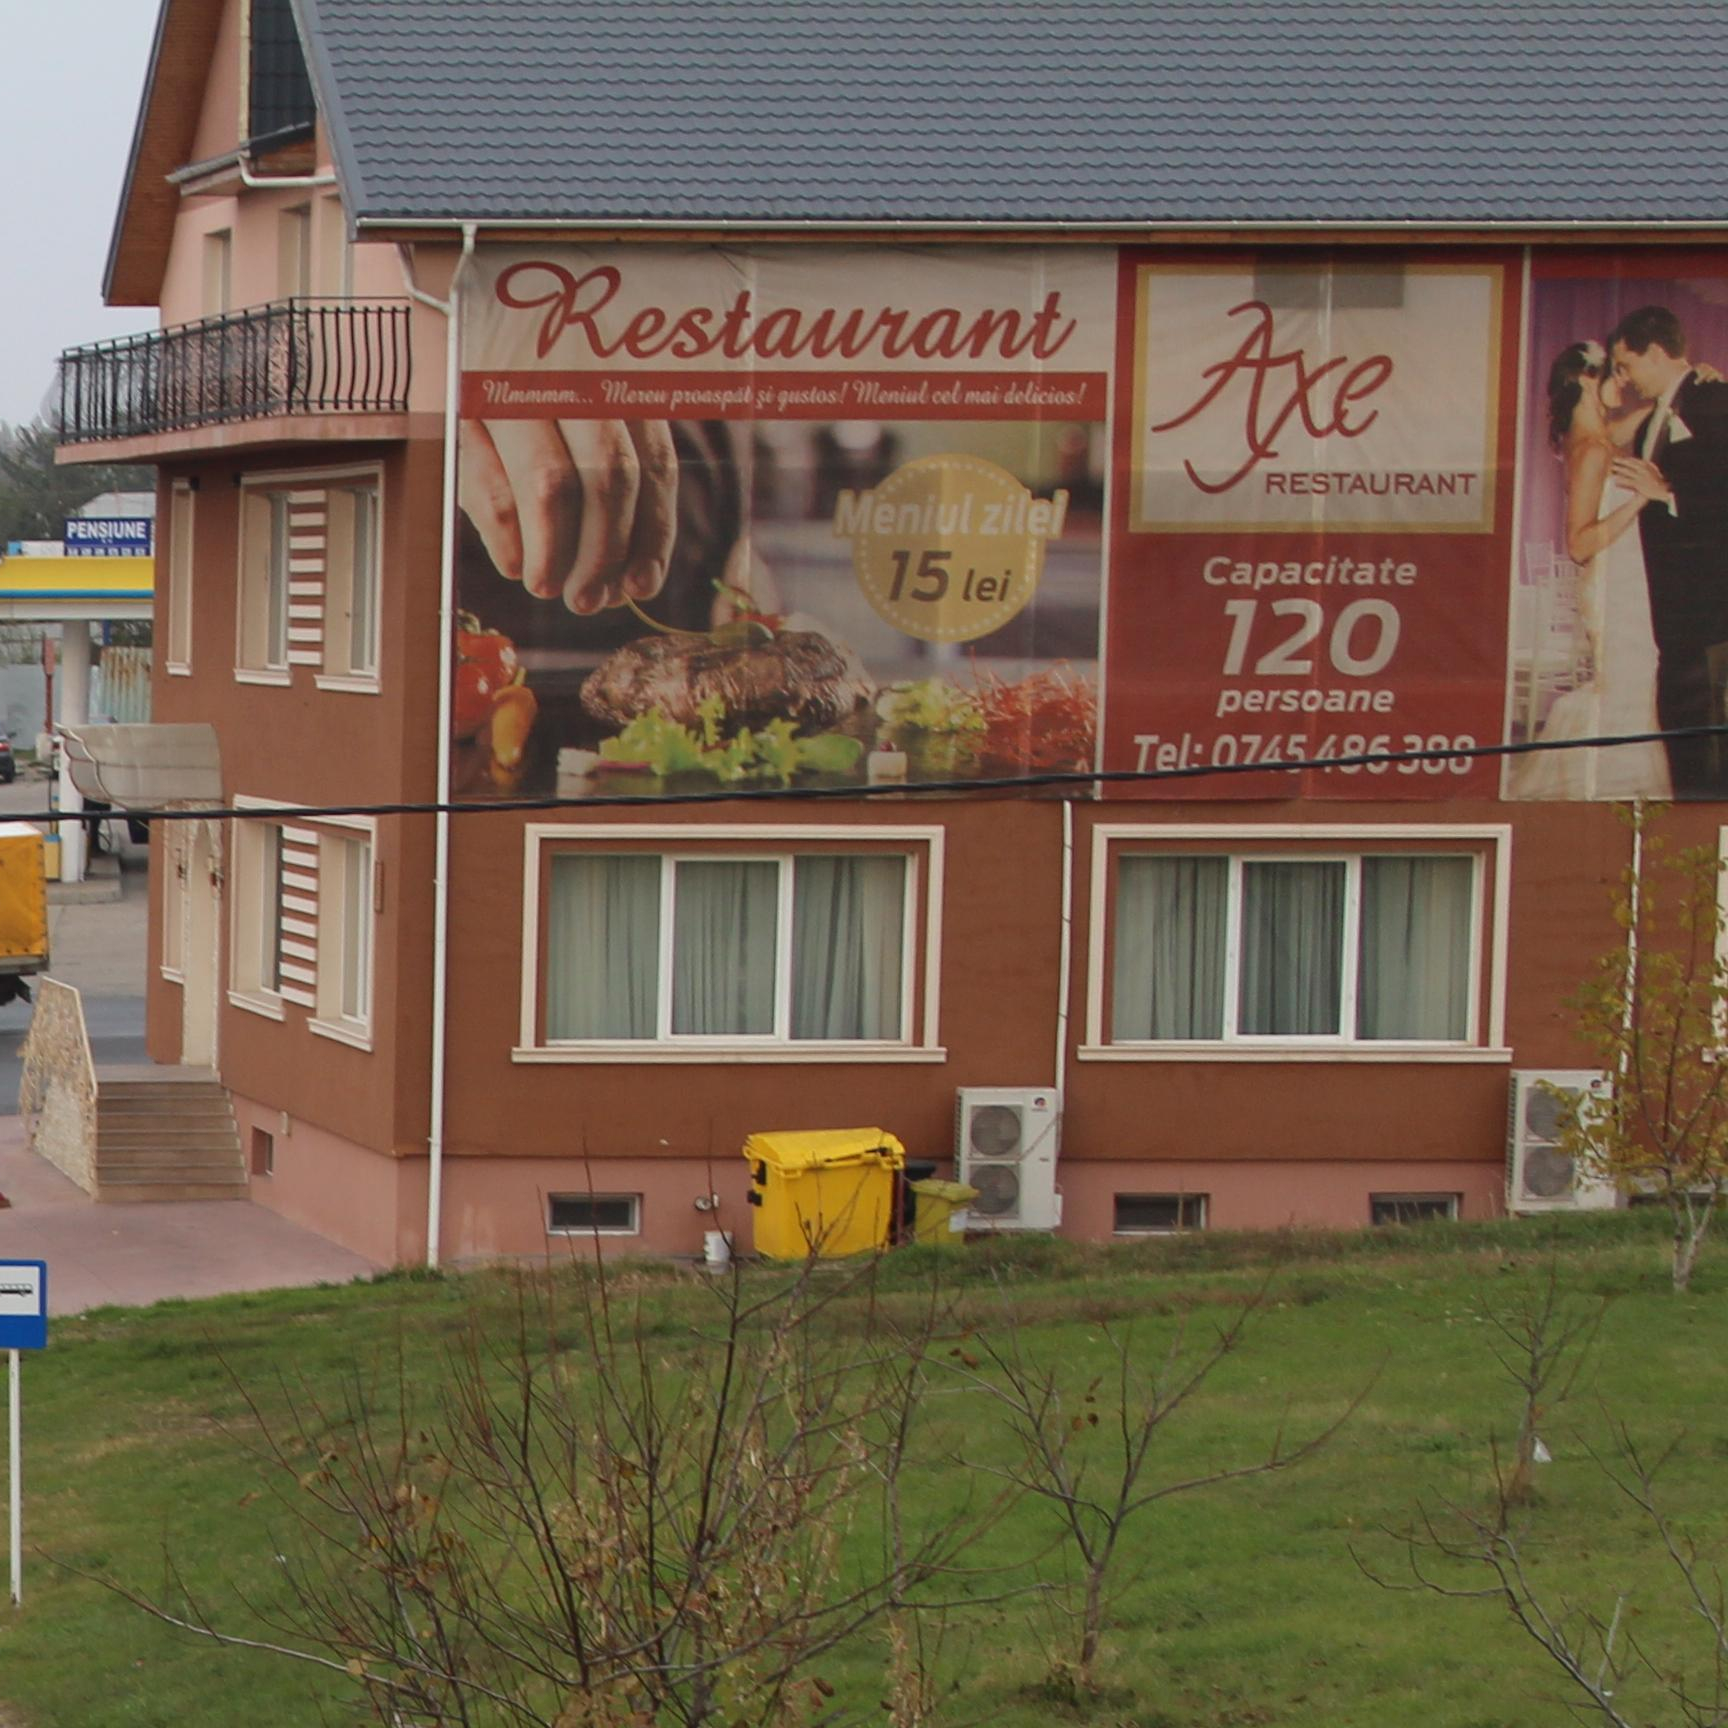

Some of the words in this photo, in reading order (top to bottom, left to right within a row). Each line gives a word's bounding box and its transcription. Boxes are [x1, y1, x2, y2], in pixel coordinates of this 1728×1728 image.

[495, 260, 1077, 360] Restaurant
[600, 379, 666, 405] Mereu
[776, 382, 847, 412] gustos!
[852, 380, 928, 405] Meniul
[931, 380, 960, 405] cel
[964, 386, 999, 405] mai
[1003, 381, 1087, 405] delicios!
[1151, 299, 1394, 494] Axe
[1265, 472, 1476, 495] RESTAURANT
[66, 520, 147, 540] PENSIUNE
[835, 491, 973, 536] Meniul
[979, 489, 1069, 536] zilei
[889, 549, 952, 602] 15
[962, 568, 1011, 602] lei
[1203, 556, 1417, 589] Capacitate
[1222, 597, 1401, 676] 120
[1215, 685, 1395, 719] persoane
[1134, 733, 1203, 774] Tel:
[1211, 734, 1308, 774] 0745
[1314, 733, 1391, 775] 486
[1396, 734, 1476, 776] 388
